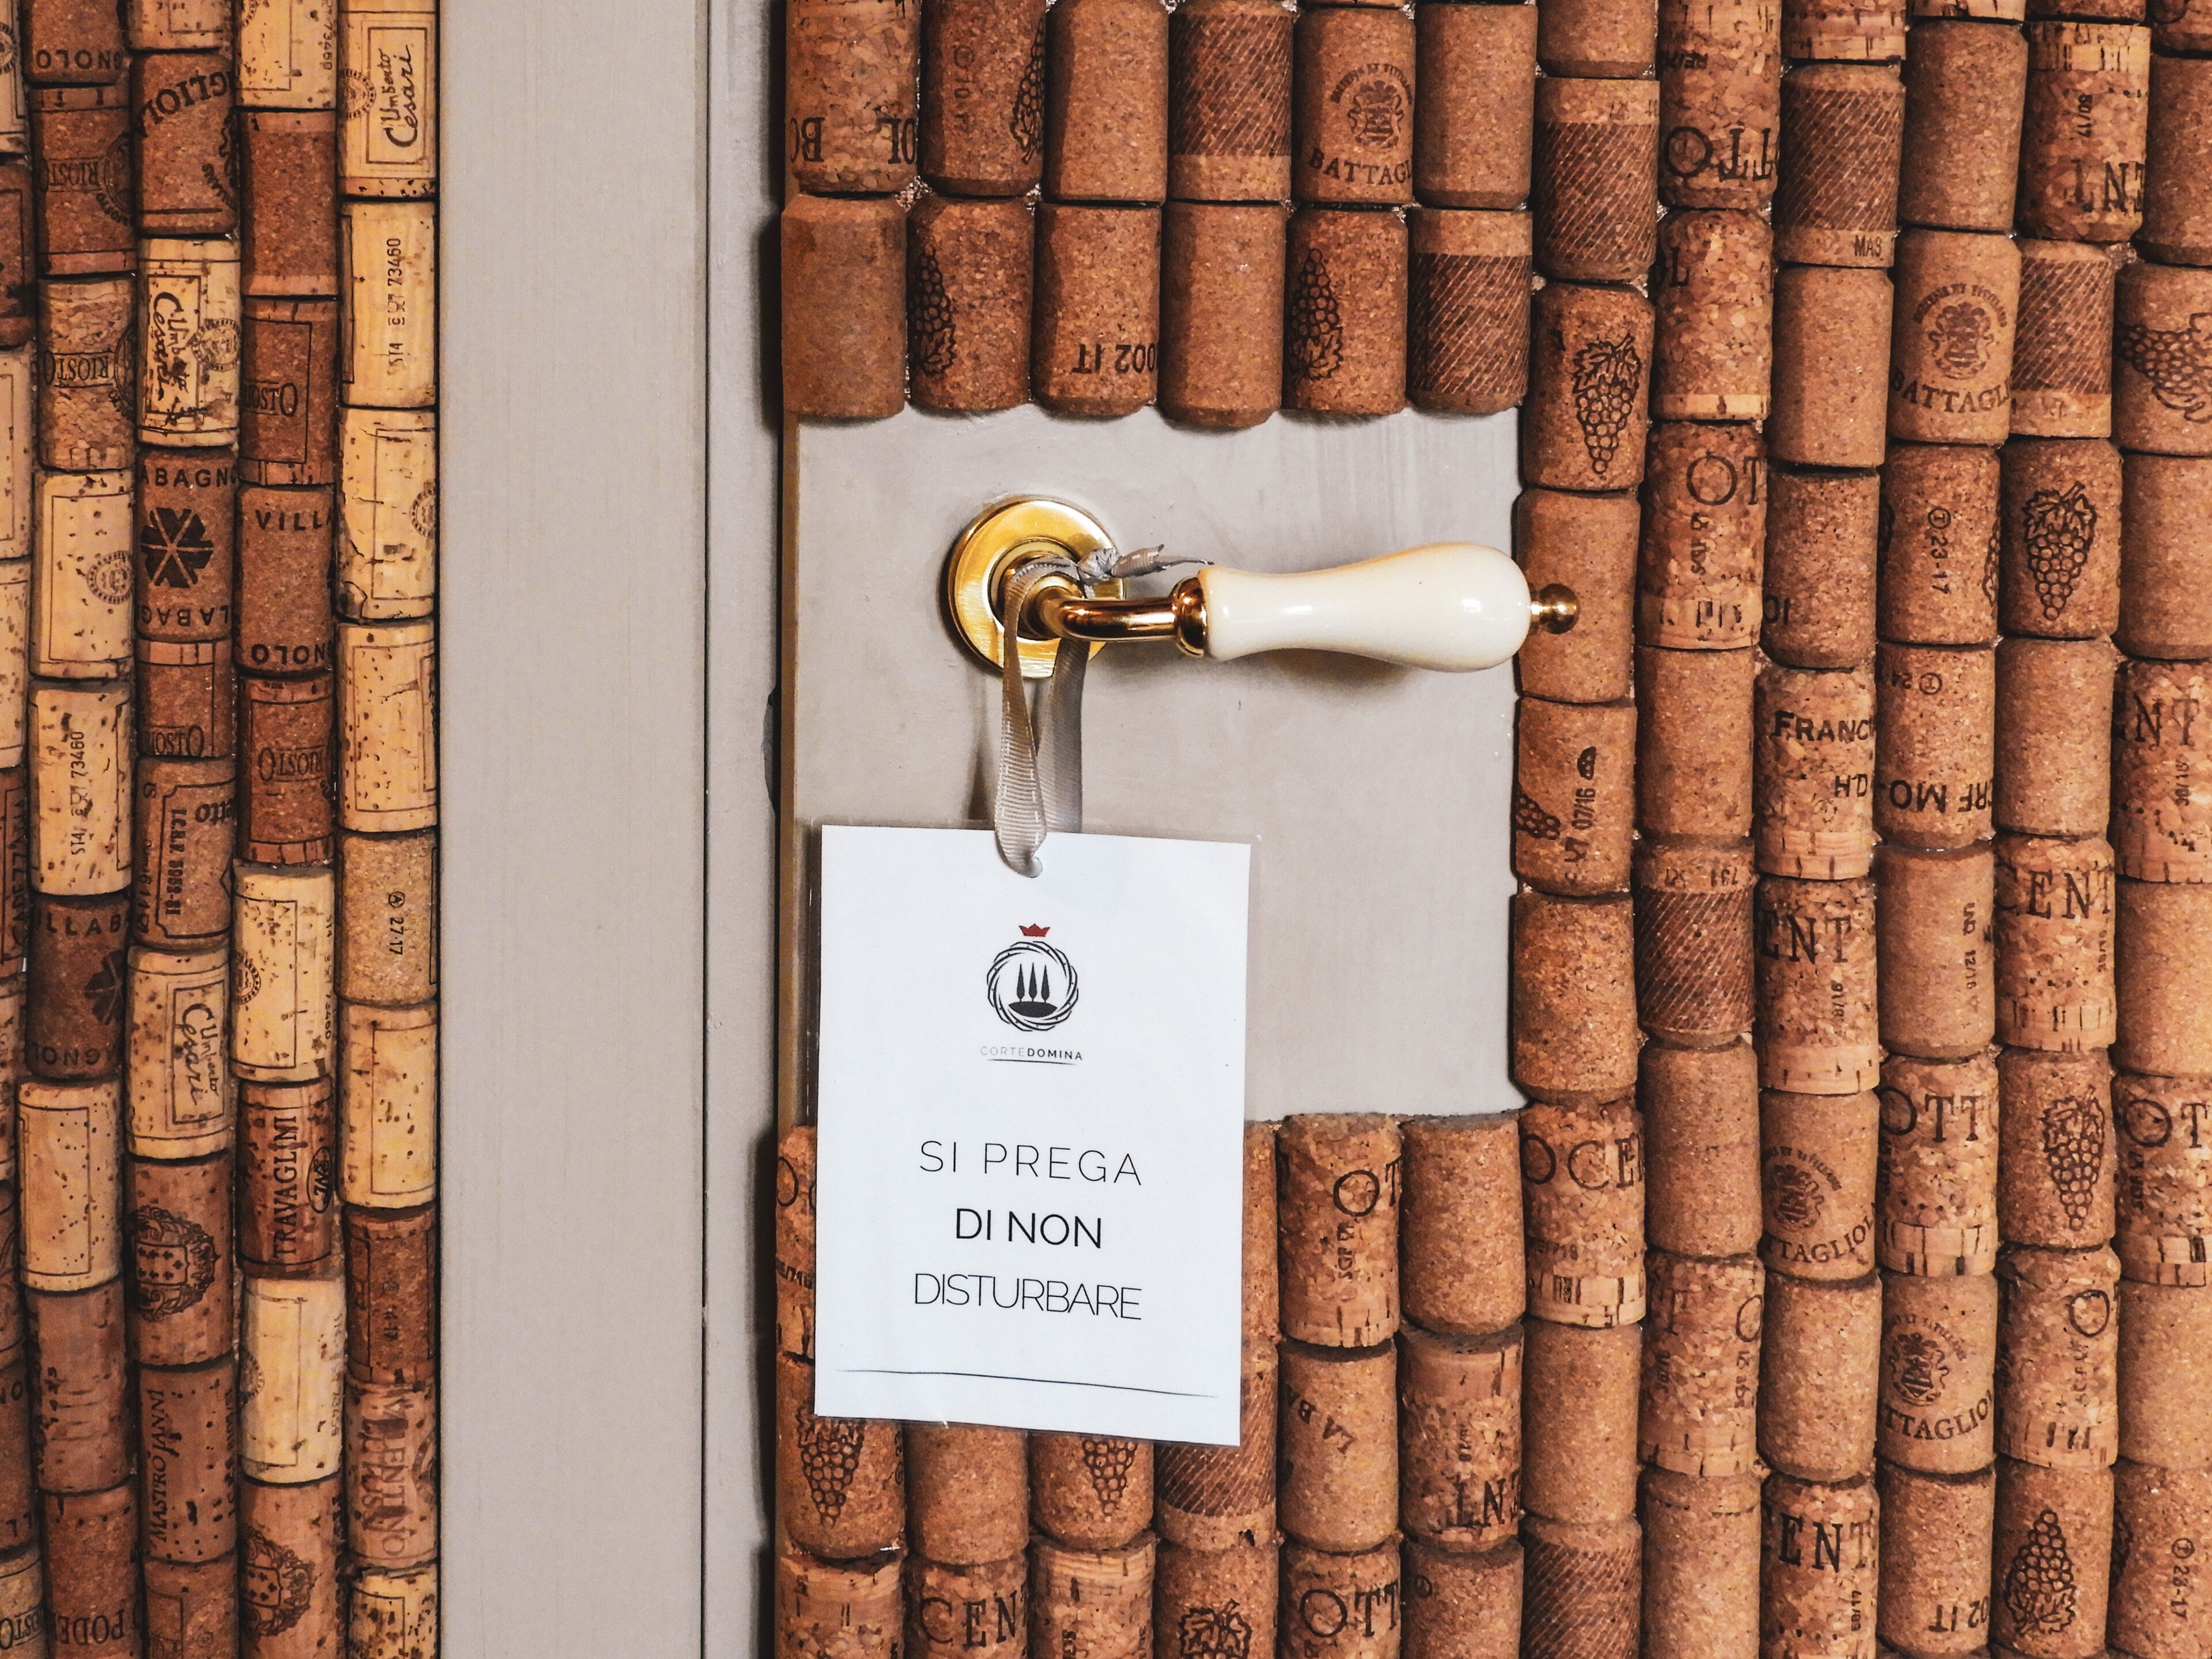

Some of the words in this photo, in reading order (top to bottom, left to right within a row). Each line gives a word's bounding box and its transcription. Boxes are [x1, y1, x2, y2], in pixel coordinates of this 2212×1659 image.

[920, 1140, 957, 1173] SI
[984, 1143, 1142, 1185] PREGA
[955, 1208, 991, 1240] DI
[1008, 1210, 1101, 1249] NON
[914, 1273, 1142, 1320] DISTURBARE
